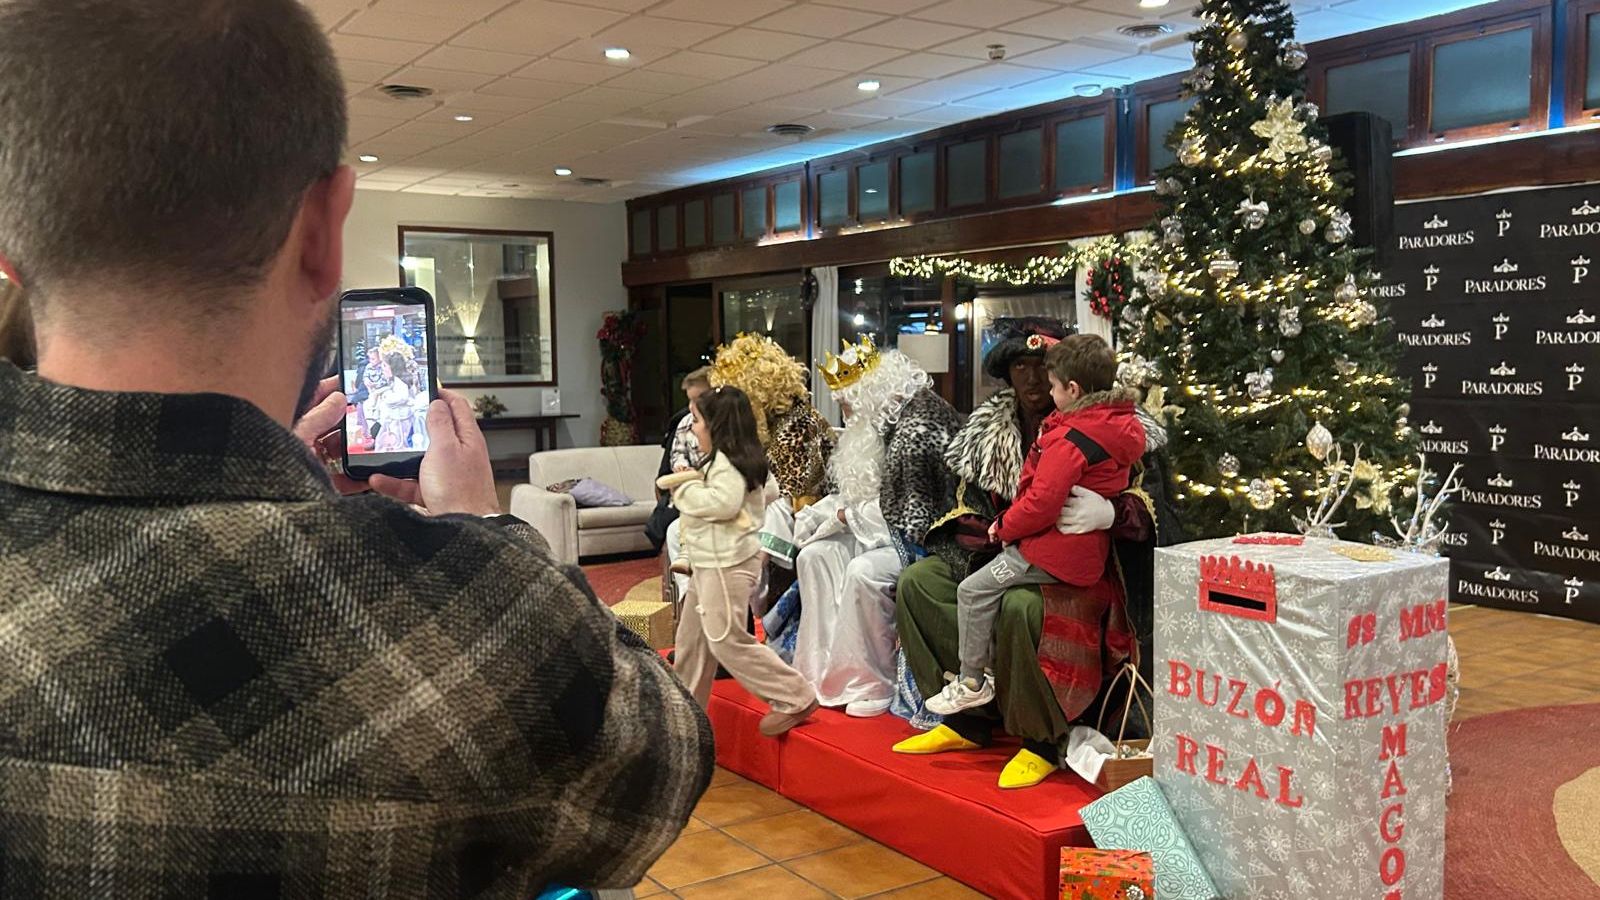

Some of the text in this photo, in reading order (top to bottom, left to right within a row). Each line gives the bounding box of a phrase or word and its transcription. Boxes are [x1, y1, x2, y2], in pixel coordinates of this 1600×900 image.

[1497, 220, 1511, 237] P
[1399, 231, 1474, 250] PARADORES
[1426, 275, 1438, 291] P
[1572, 266, 1588, 284] P
[1464, 276, 1546, 293] PARADORES
[1398, 332, 1471, 346] PARADORES
[1495, 324, 1508, 340] P
[1424, 373, 1436, 389] P
[1461, 380, 1543, 395] PARADORES
[1568, 374, 1583, 391] P
[1416, 440, 1468, 454] ADORES
[1491, 435, 1505, 451] P
[1461, 490, 1542, 508] PARADORES
[1565, 491, 1580, 507] P
[1441, 532, 1468, 546] RES
[1491, 529, 1505, 545] P
[1458, 580, 1540, 604] PARADORES
[1565, 587, 1581, 604] P
[1399, 599, 1446, 642] MM
[1344, 662, 1448, 720] REYES
[1175, 734, 1303, 808] REAL
[1379, 723, 1408, 900] MAGO
